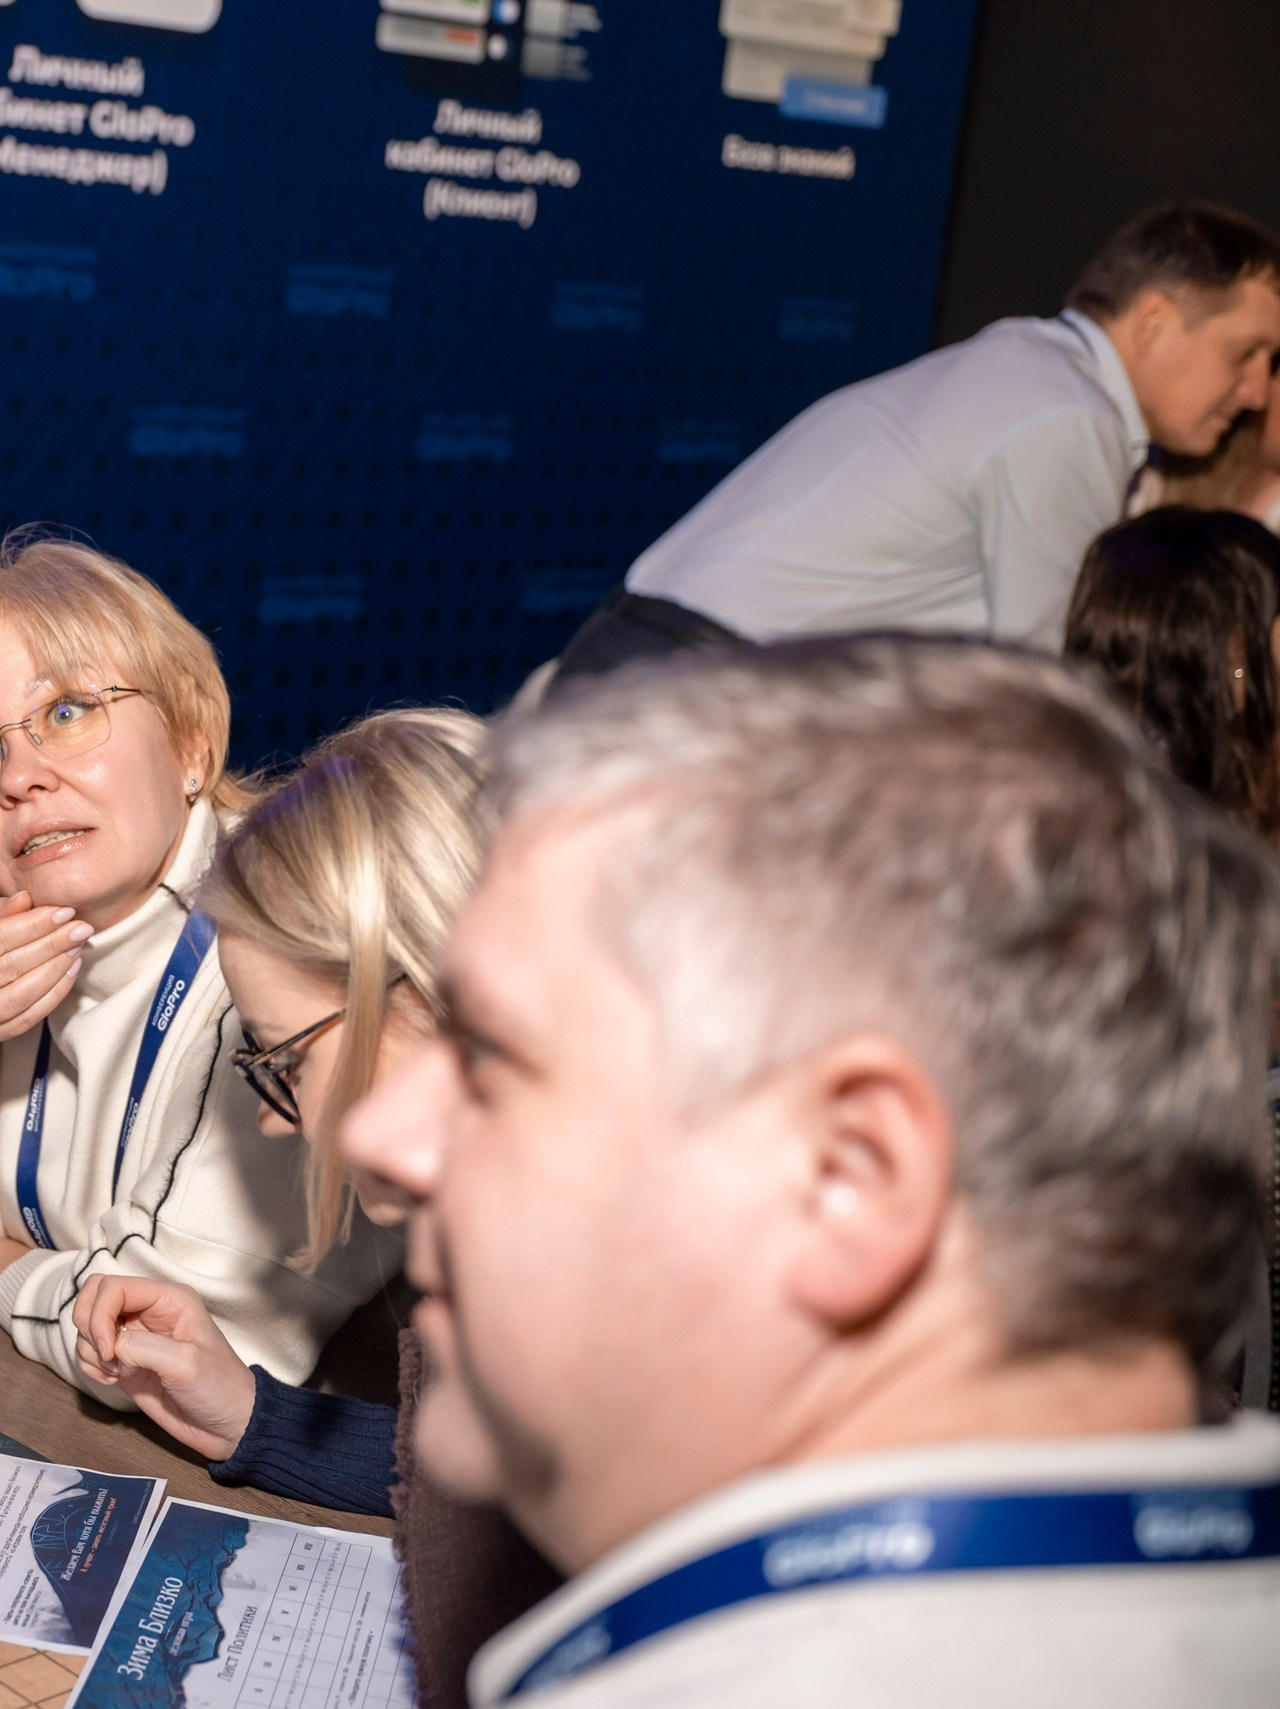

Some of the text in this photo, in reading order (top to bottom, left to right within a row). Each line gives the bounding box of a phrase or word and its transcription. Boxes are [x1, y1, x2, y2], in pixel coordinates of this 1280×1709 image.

[8, 44, 145, 97] Личный
[89, 100, 195, 147] GloPro
[157, 980, 185, 1031] GloPro
[26, 1078, 40, 1131] GloPro
[117, 1640, 158, 1681] Зима
[138, 1576, 184, 1643] Близко
[216, 1604, 258, 1681] Лист Политики
